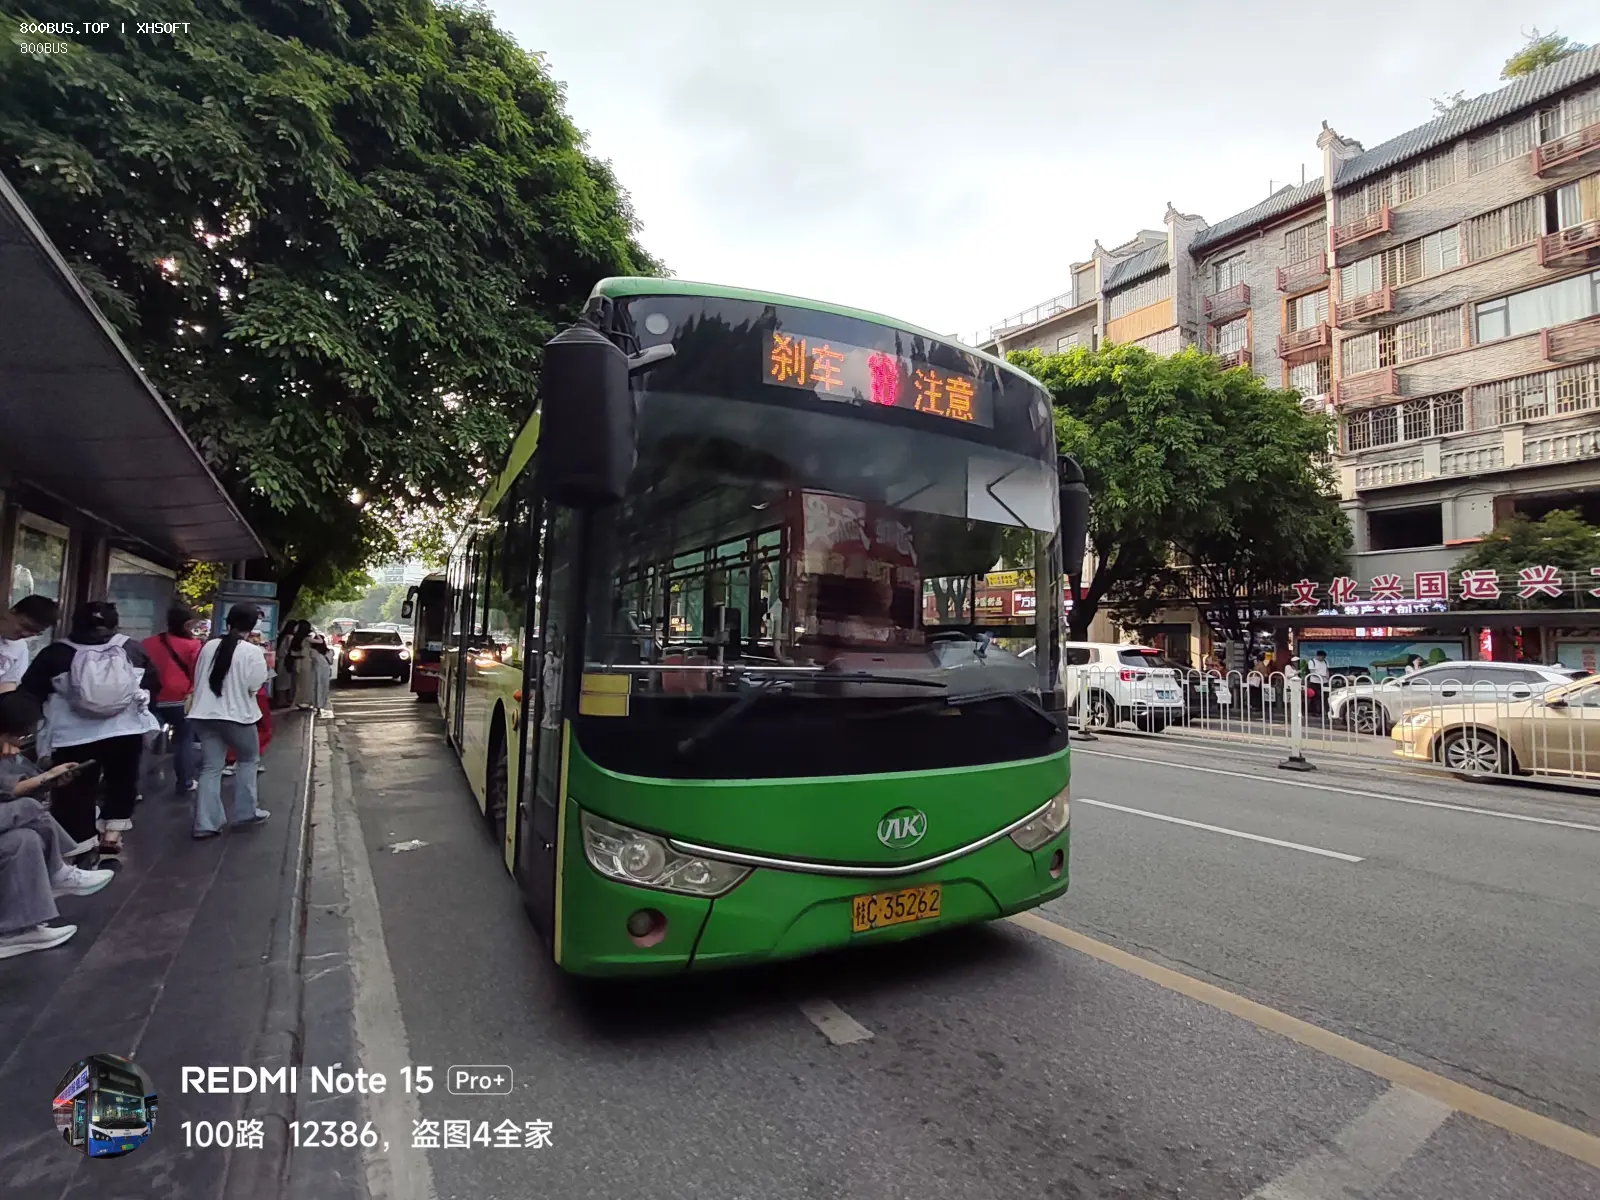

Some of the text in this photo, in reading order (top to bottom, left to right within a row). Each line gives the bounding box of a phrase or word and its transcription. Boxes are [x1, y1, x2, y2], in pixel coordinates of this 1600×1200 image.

[771, 332, 844, 391] 刹车
[914, 368, 974, 421] 注意
[1291, 565, 1600, 606] 文化兴国运兴
